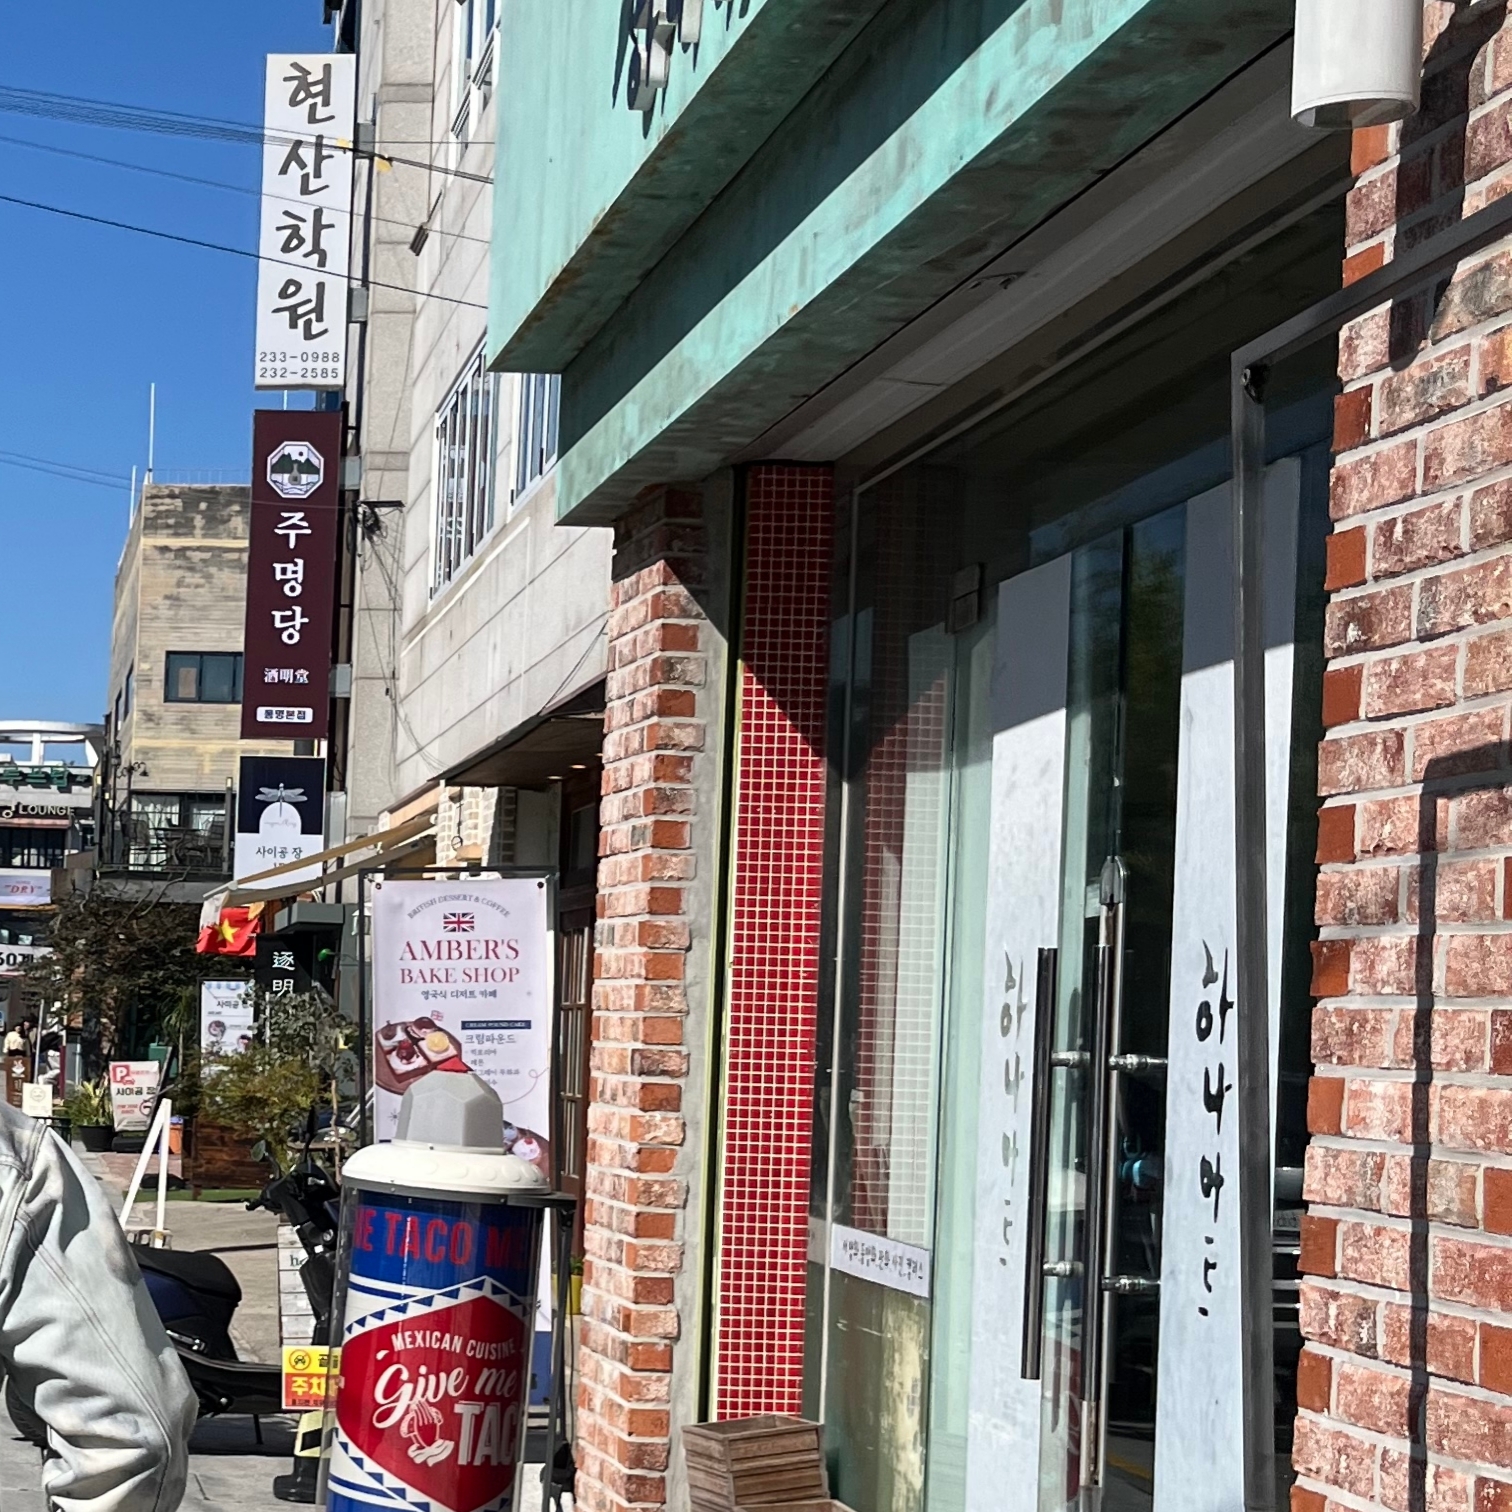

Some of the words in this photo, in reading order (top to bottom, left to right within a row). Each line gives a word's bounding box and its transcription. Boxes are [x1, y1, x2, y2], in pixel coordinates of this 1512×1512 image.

[271, 61, 335, 341] 현산학원
[259, 352, 340, 363] 233-0988
[259, 367, 339, 379] 232-2585
[271, 511, 312, 645] 주명당
[19, 805, 75, 816] LOUNGE
[256, 846, 289, 859] 사이공
[407, 897, 436, 919] BRITISH
[437, 894, 473, 904] DESSERT
[481, 898, 511, 918] COFFEE
[399, 939, 519, 961] AMBER'S
[399, 967, 457, 984] BAKE
[462, 967, 520, 983] SHOP
[421, 989, 447, 1000] 영국식
[450, 989, 477, 999] 디저트
[479, 989, 498, 999] 카페
[464, 1033, 517, 1045] 크림파운드
[385, 1212, 472, 1265] TACO
[484, 1225, 529, 1269] M
[391, 1330, 463, 1353] MEXICAN
[466, 1338, 516, 1360] CUISINE
[373, 1363, 469, 1429] Give
[474, 1367, 519, 1397] me
[453, 1401, 520, 1466] TAC
